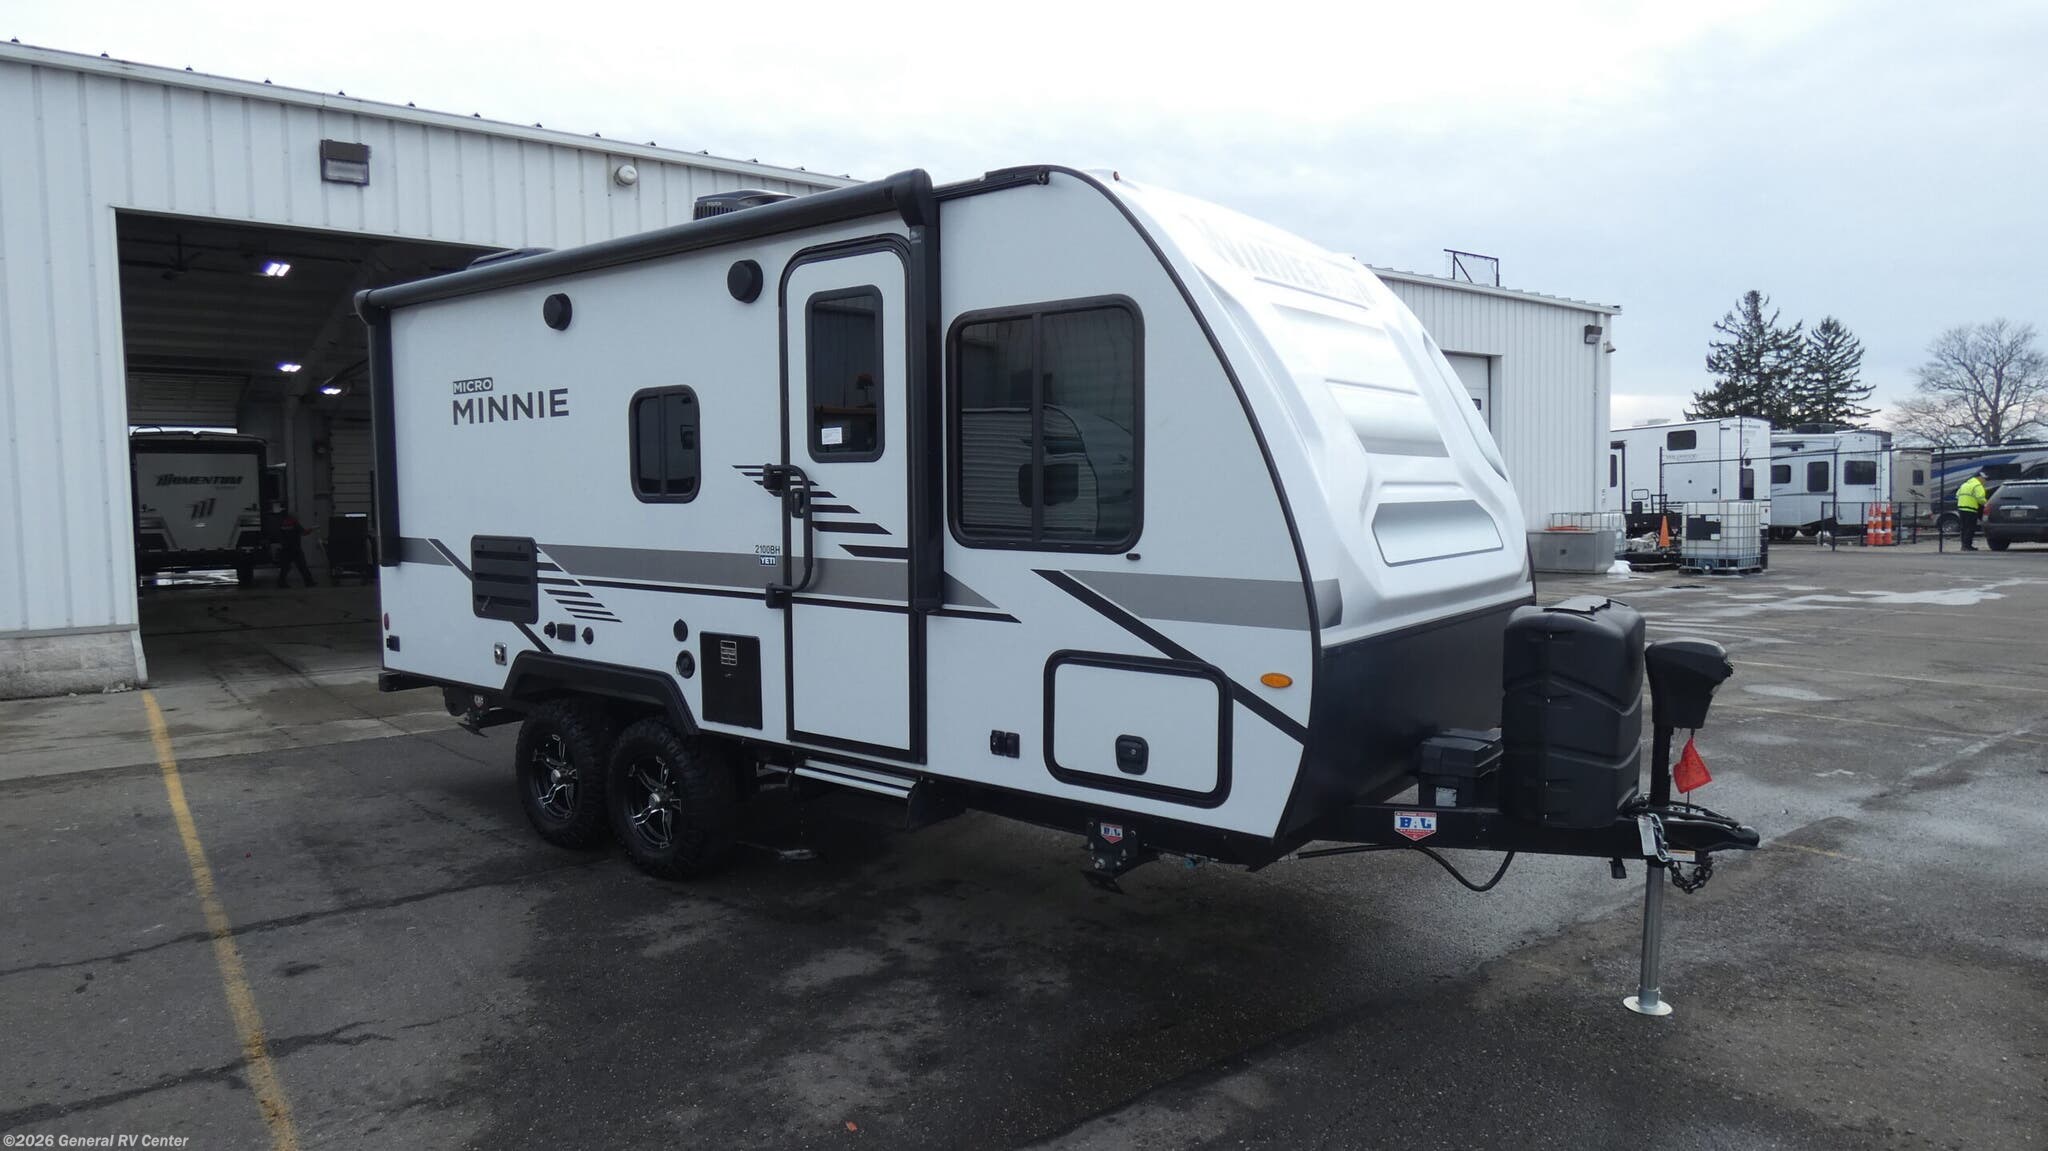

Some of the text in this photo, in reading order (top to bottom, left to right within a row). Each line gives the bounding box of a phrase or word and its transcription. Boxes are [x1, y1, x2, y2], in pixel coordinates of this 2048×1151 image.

[453, 378, 493, 394] MICRO
[452, 388, 570, 426] MINNIE
[760, 556, 776, 565] YETI
